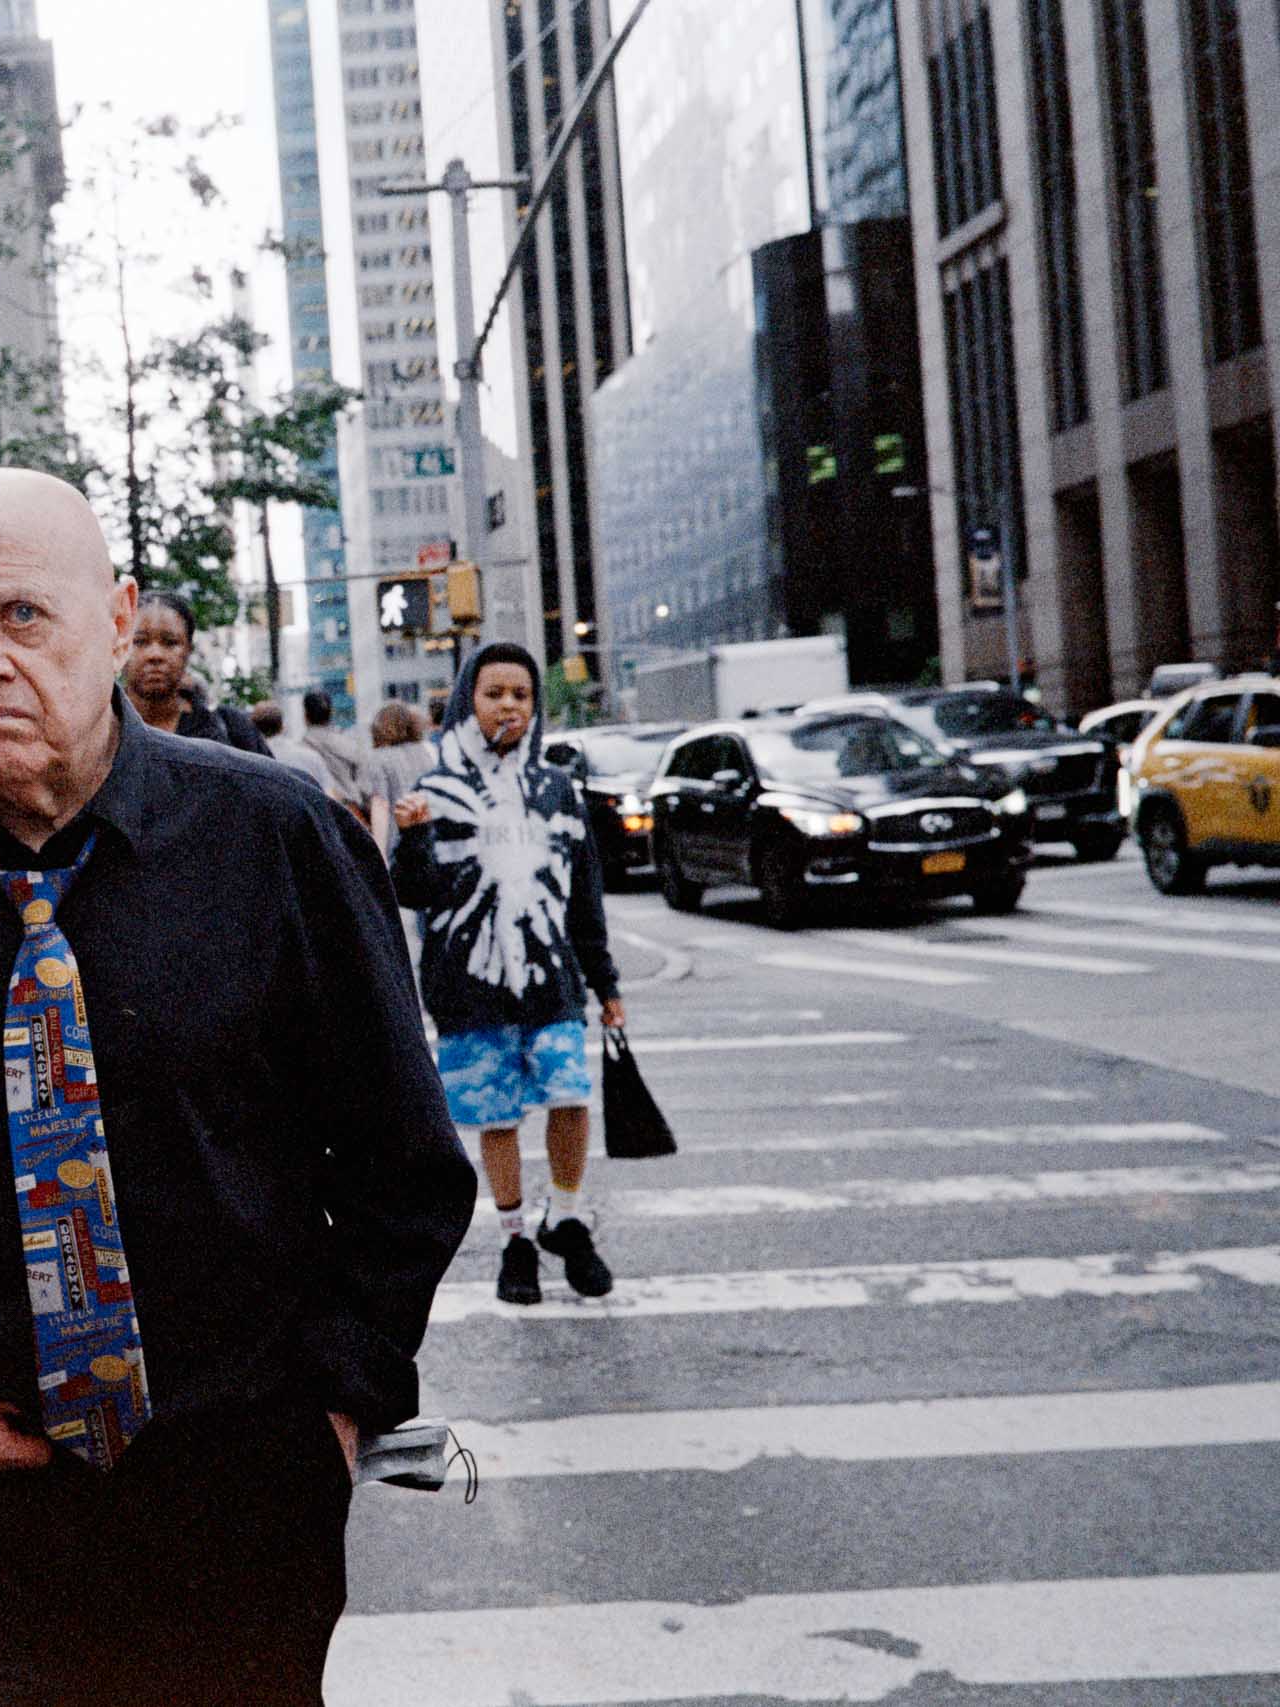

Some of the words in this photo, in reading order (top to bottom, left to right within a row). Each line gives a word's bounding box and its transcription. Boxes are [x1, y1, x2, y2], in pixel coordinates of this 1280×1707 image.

[33, 1022, 51, 1102] BROADWAY
[47, 1008, 64, 1087] BELASCO
[30, 1117, 87, 1138] MAJESTIC
